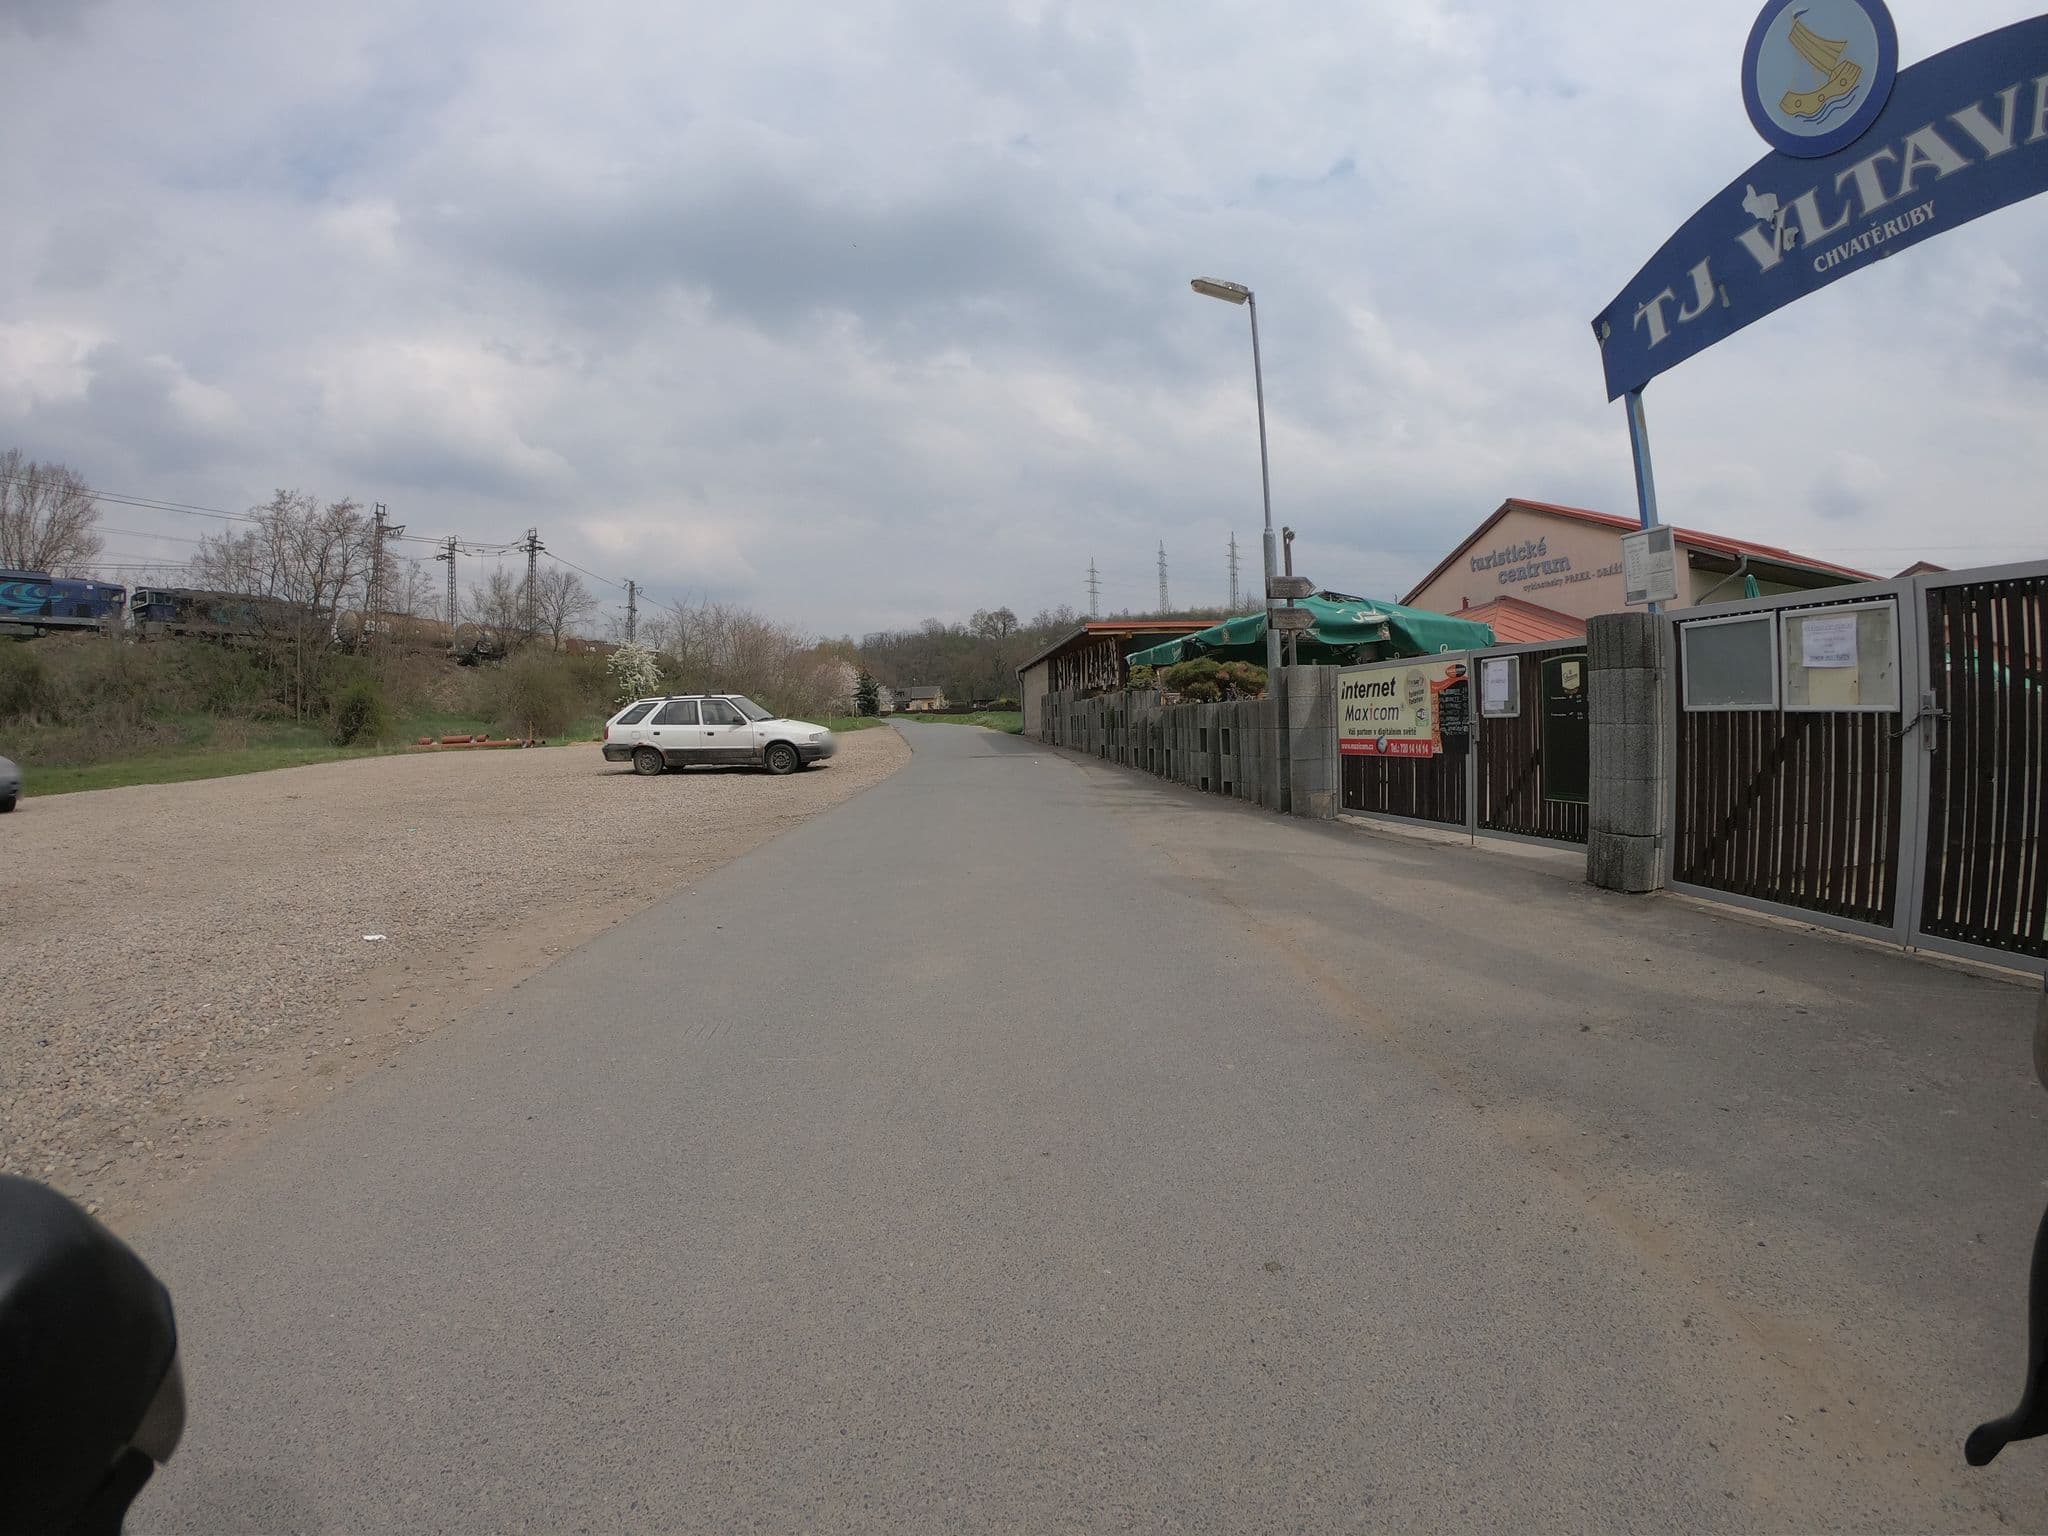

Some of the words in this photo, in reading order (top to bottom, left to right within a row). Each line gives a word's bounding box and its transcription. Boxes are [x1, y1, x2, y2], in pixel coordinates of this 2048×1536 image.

[1812, 200, 1936, 273] CHVATĚRUBY
[1470, 536, 1547, 572] turistické
[1498, 556, 1571, 584] centrum
[1341, 676, 1396, 700] internet
[1344, 703, 1400, 722] Maxicom
